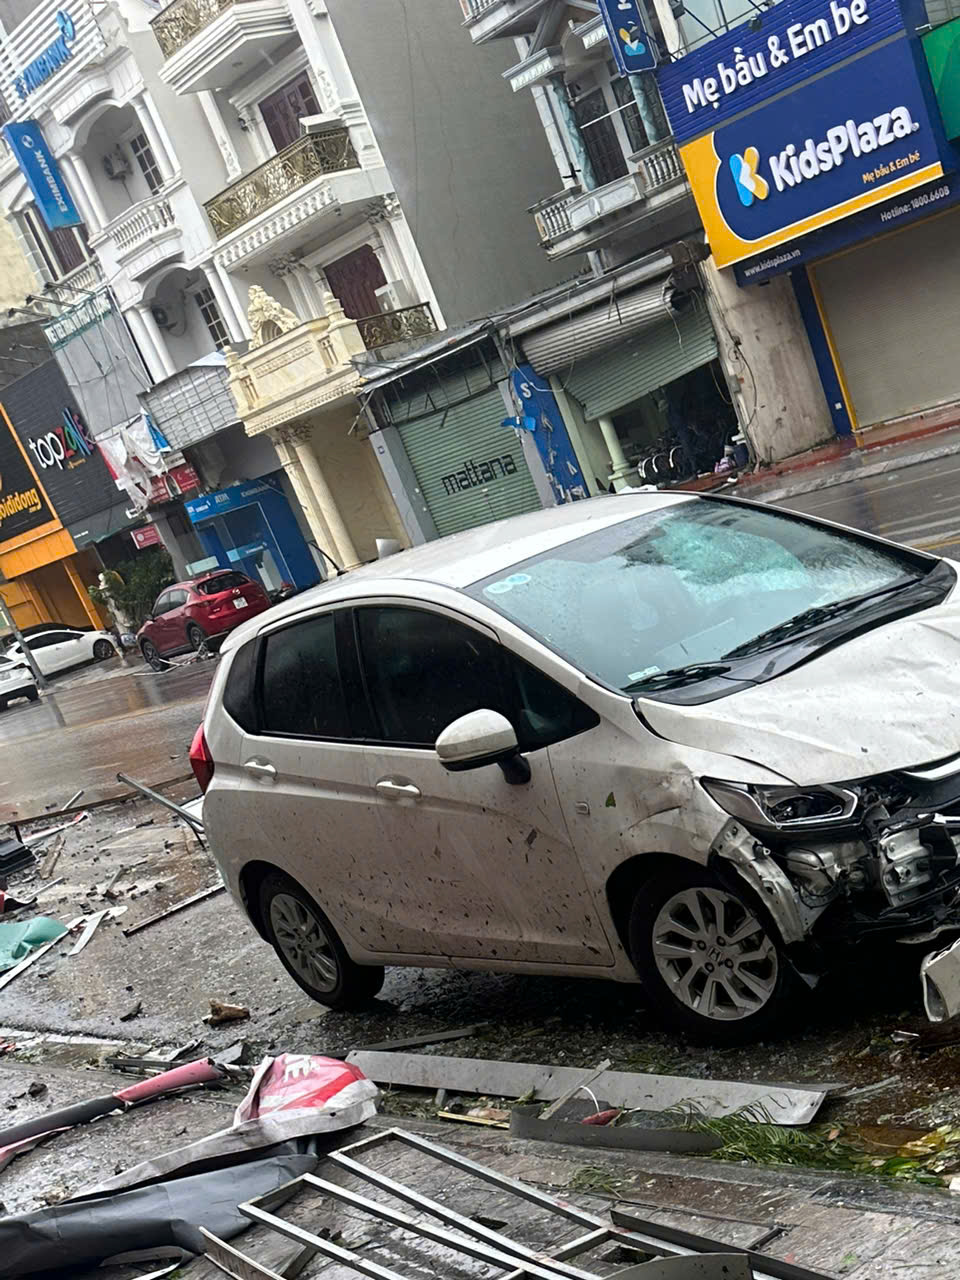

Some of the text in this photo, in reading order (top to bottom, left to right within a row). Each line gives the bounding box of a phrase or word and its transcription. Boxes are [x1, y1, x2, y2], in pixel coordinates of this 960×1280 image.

[682, 78, 720, 113] Mẹ
[717, 47, 768, 94] bầu
[768, 35, 789, 68] &
[786, 18, 832, 58] Em
[768, 106, 915, 193] KidsPlaza
[895, 156, 909, 169] Em
[34, 149, 68, 213] EXIMBANK
[880, 203, 911, 222] Hotline:
[441, 454, 518, 496] mattana
[0, 488, 42, 521] oididong
